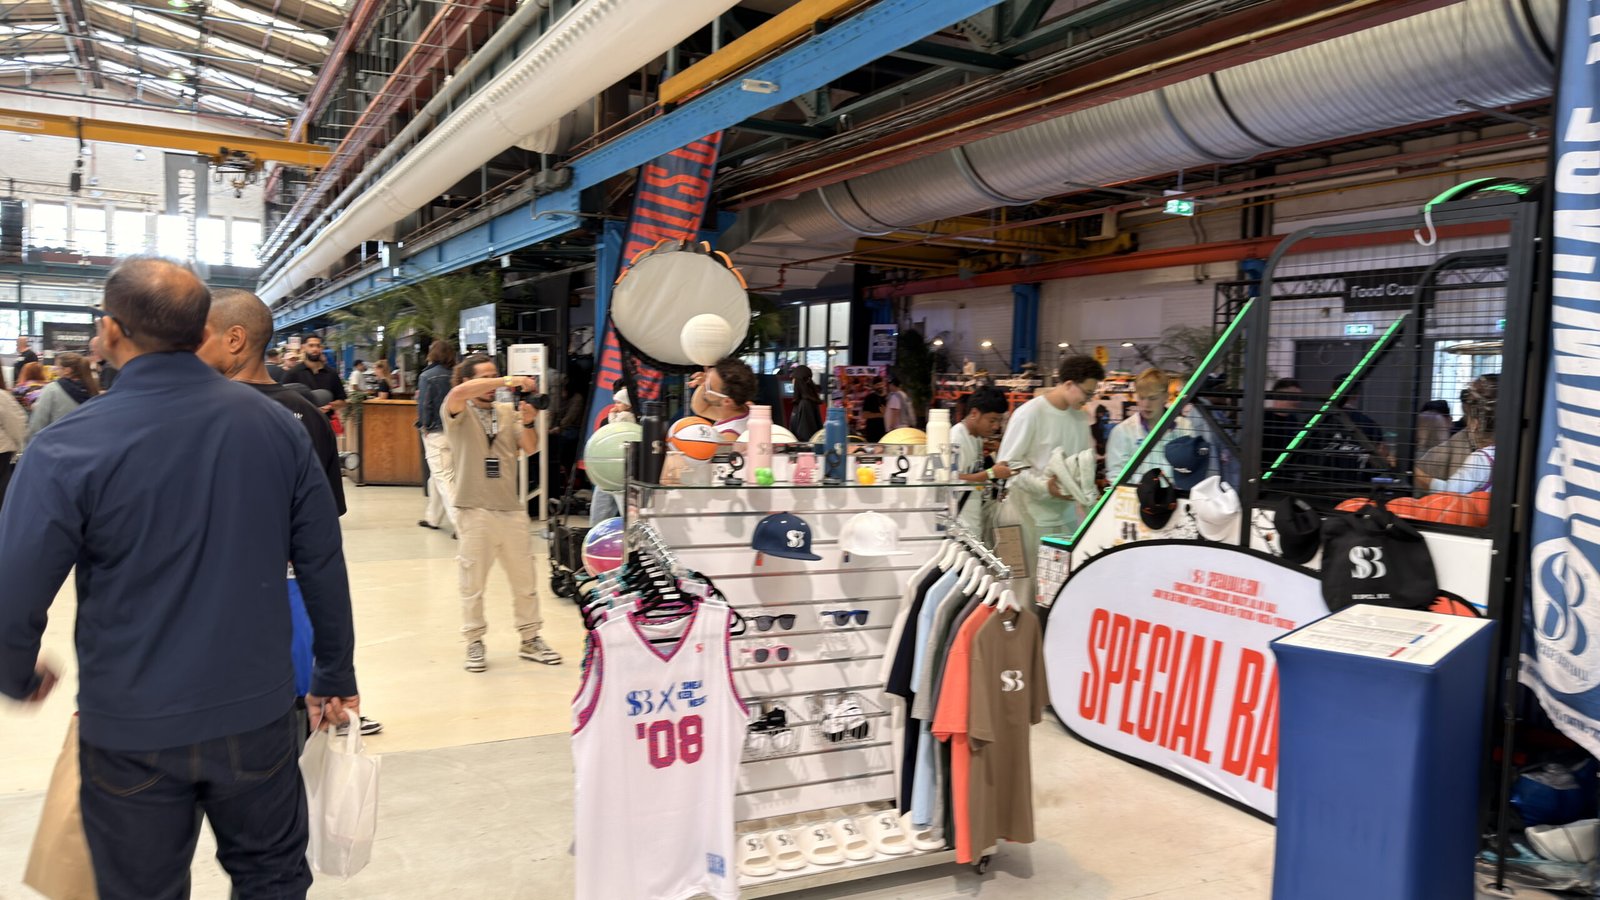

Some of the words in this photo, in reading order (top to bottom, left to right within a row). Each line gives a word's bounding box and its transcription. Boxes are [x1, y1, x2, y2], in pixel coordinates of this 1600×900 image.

[1350, 284, 1385, 298] Food
[1077, 607, 1224, 765] SPECIAL
[635, 714, 705, 769] '08
